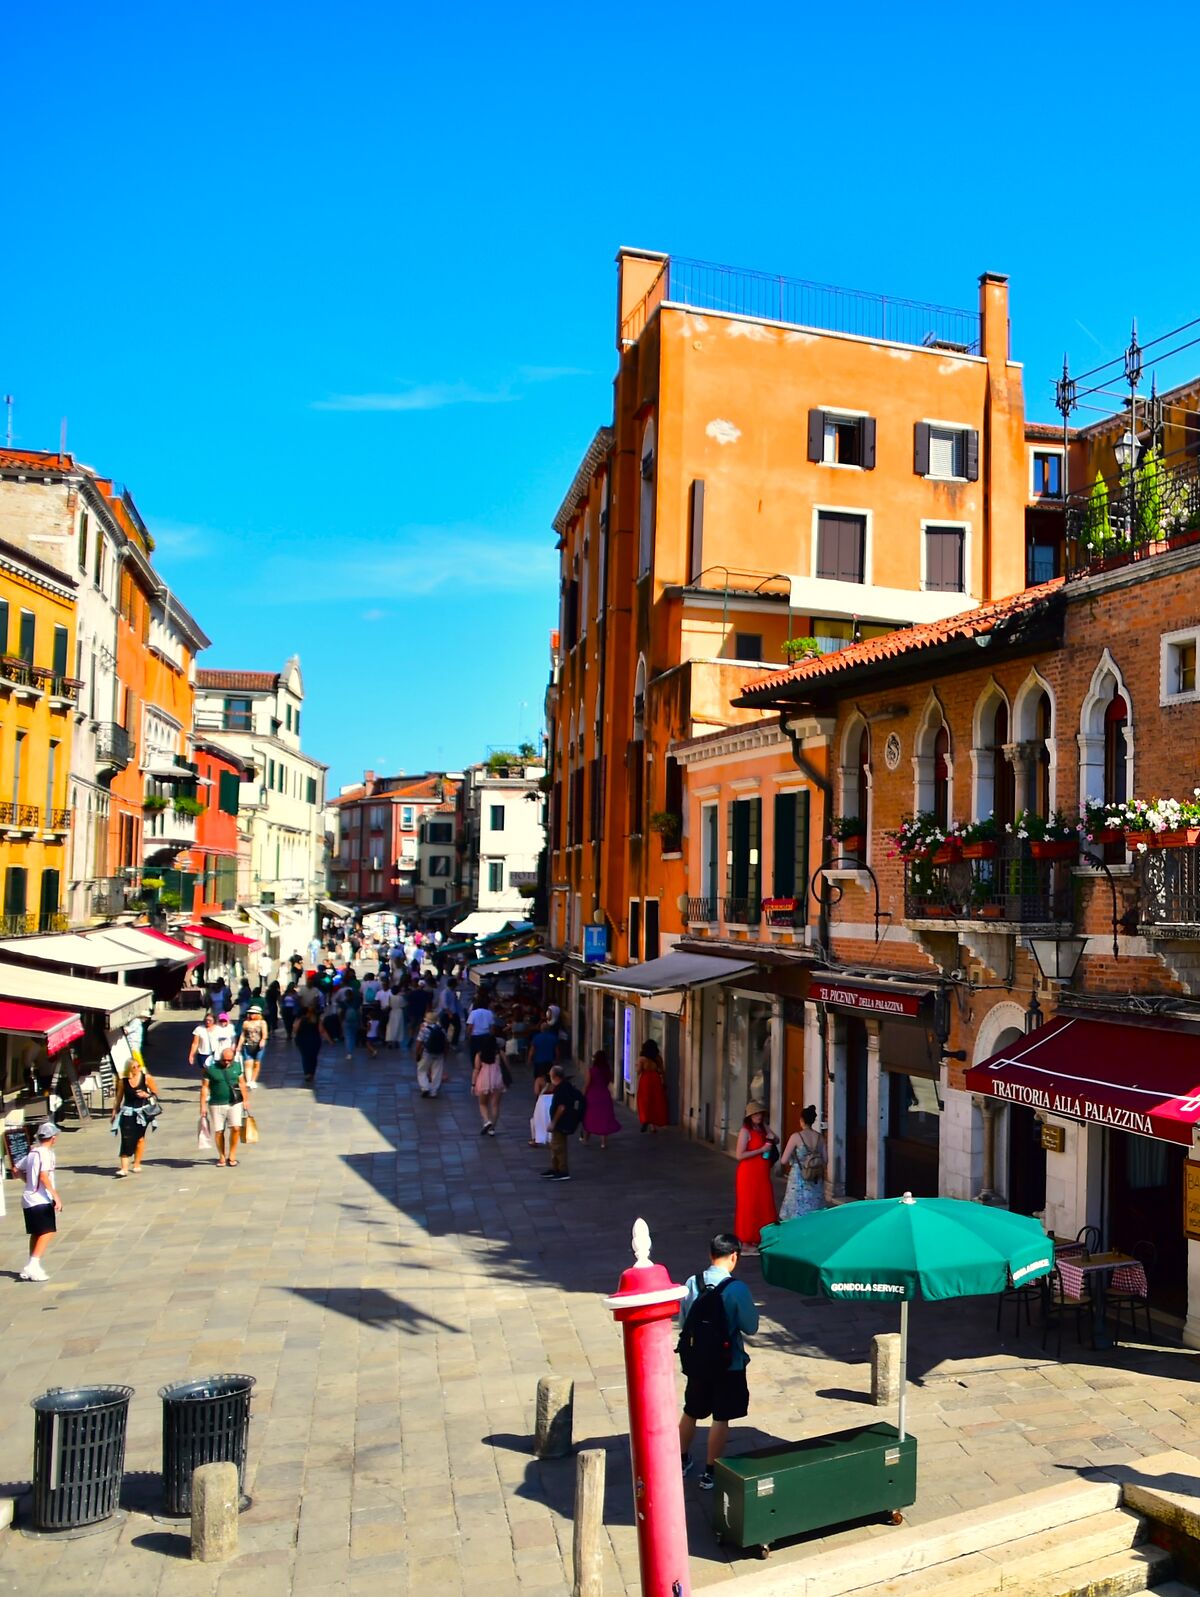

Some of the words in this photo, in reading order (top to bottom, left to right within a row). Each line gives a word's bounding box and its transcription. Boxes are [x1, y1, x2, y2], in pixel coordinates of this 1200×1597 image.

[511, 872, 537, 880] HOTE
[859, 997, 874, 1008] DELLA
[875, 1000, 904, 1012] PALAZZINA
[992, 1079, 1050, 1108] TRATTORIA
[1053, 1094, 1081, 1116] ALLA
[1084, 1101, 1153, 1134] PALAZZINA
[831, 1283, 872, 1292] GONDOLA
[872, 1283, 905, 1294] SERVICE
